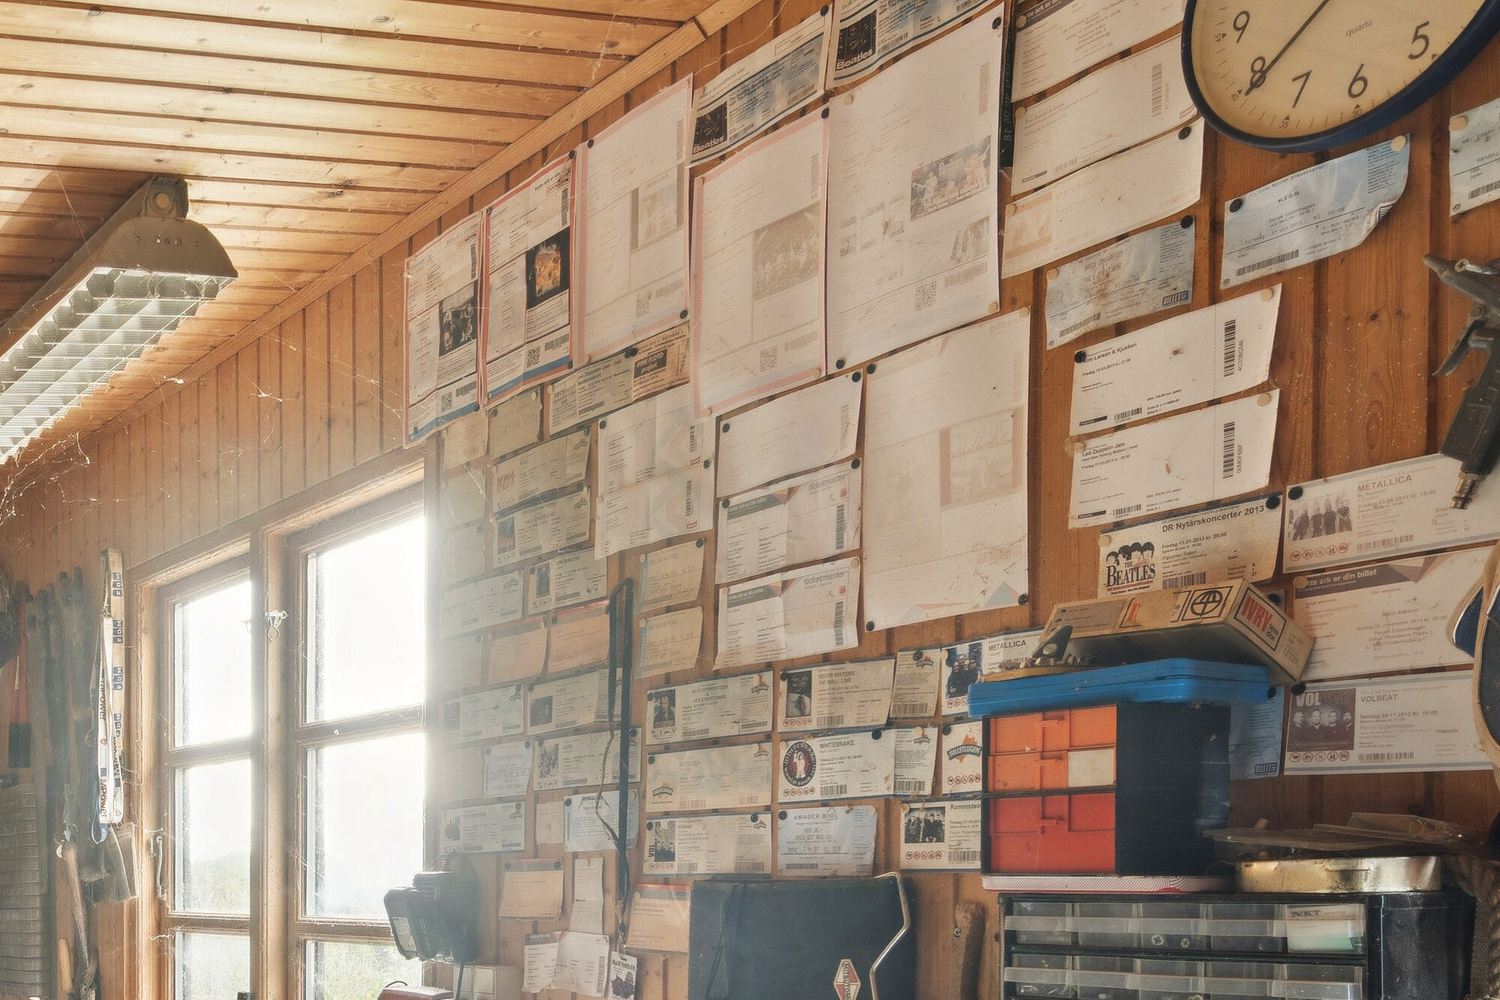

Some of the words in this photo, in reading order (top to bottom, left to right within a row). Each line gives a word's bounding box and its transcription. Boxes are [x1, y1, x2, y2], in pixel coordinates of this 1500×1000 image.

[1232, 10, 1250, 44] 9
[1345, 18, 1373, 38] quartz
[1408, 21, 1430, 60] 5
[836, 49, 873, 70] Beatles
[1250, 56, 1267, 89] 8
[1347, 63, 1368, 98] 6
[1291, 70, 1312, 109] 7
[1352, 108, 1362, 117] 30
[1278, 119, 1290, 129] 35
[1277, 190, 1301, 203] KISS
[1094, 350, 1112, 361] Larsen
[1082, 448, 1092, 457] Led
[1092, 444, 1114, 457] Zeppelin
[1114, 441, 1126, 449] Jam
[1357, 474, 1413, 493] METALLICA
[1162, 523, 1174, 533] DR
[1175, 509, 1242, 531] Nytårskoncerter
[1243, 504, 1265, 516] 2013
[1123, 561, 1133, 570] THE
[804, 570, 846, 586] ticketmaster
[1105, 563, 1157, 588] BEATLES
[1319, 575, 1332, 585] ark
[1333, 575, 1342, 583] er
[1342, 572, 1356, 581] din
[1357, 568, 1378, 578] billet
[1240, 596, 1273, 632] IVRY
[988, 640, 1027, 652] METALLICA
[1360, 693, 1399, 703] VOLBEAT
[819, 739, 855, 749] WHITESNAKE
[1291, 909, 1321, 919] NKT
